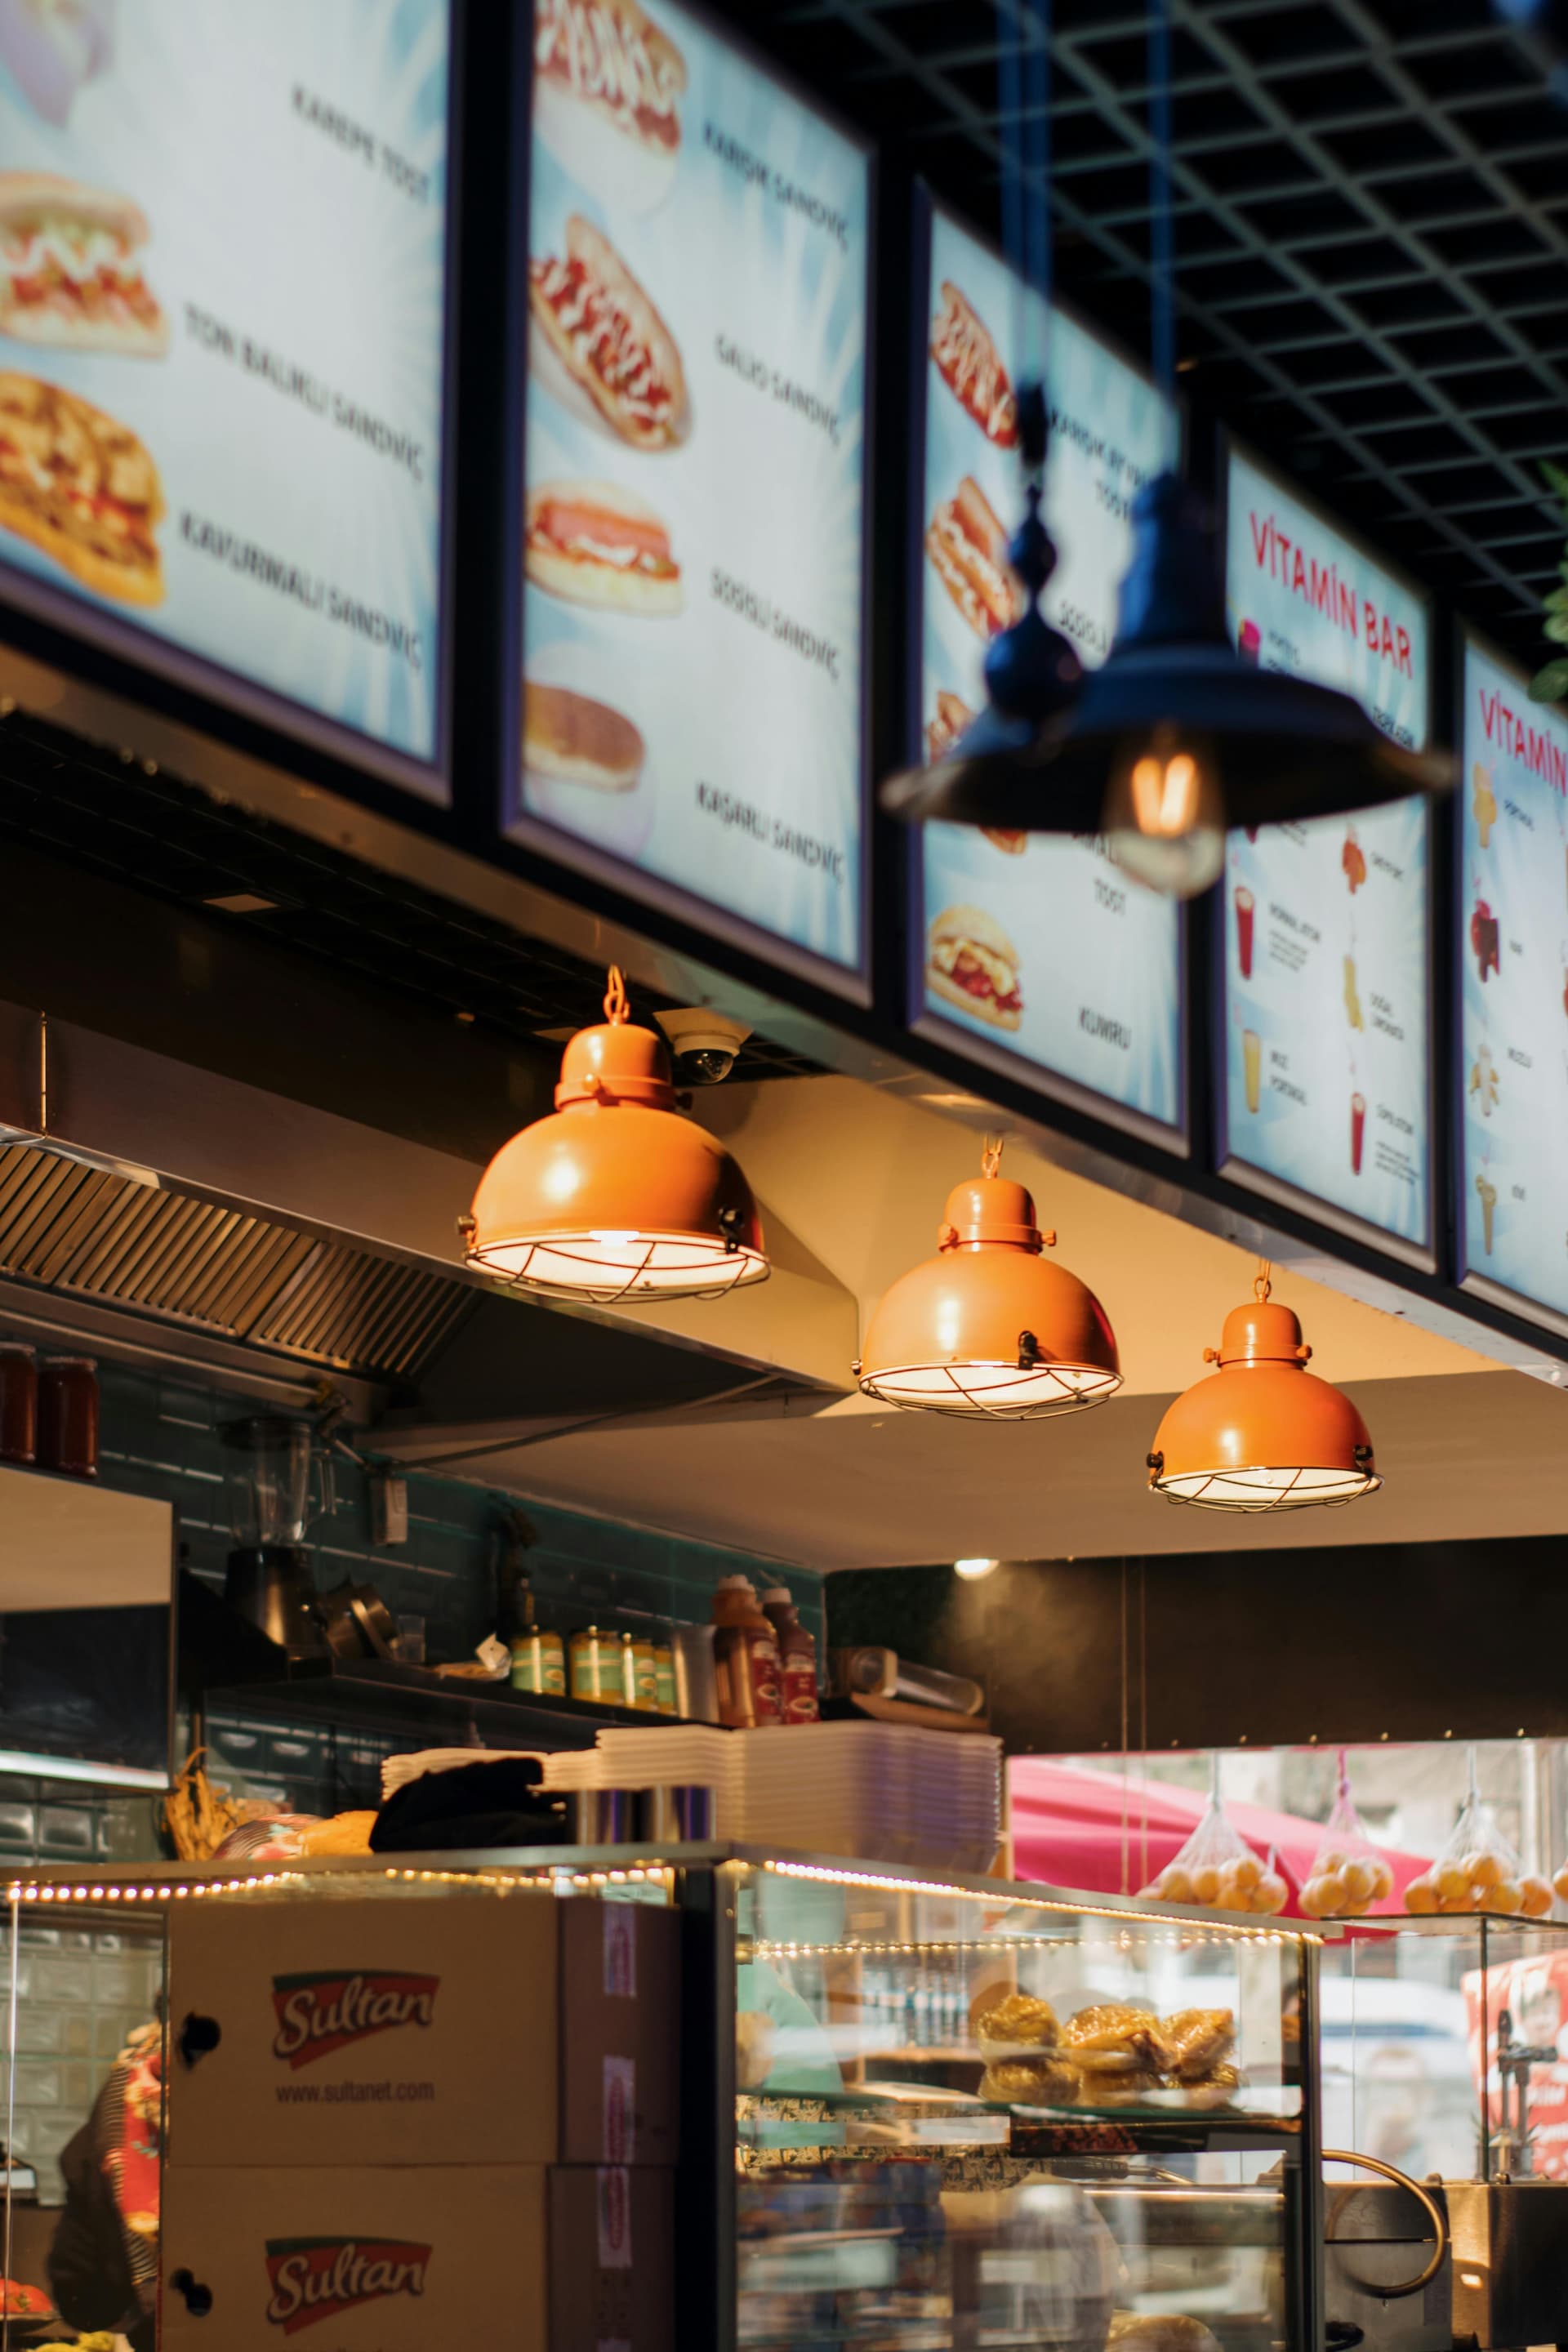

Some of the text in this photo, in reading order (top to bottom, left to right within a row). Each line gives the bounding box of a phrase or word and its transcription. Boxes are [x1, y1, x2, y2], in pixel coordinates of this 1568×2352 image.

[183, 302, 234, 359] TON
[180, 510, 324, 610] KAVURMALI
[1250, 510, 1412, 679] VİTAMİN BAR
[1479, 689, 1566, 797] VİTAMİN
[274, 1976, 431, 2057] Sultan
[276, 2080, 434, 2102] www.sultanet.com
[267, 2243, 423, 2323] Sultan
